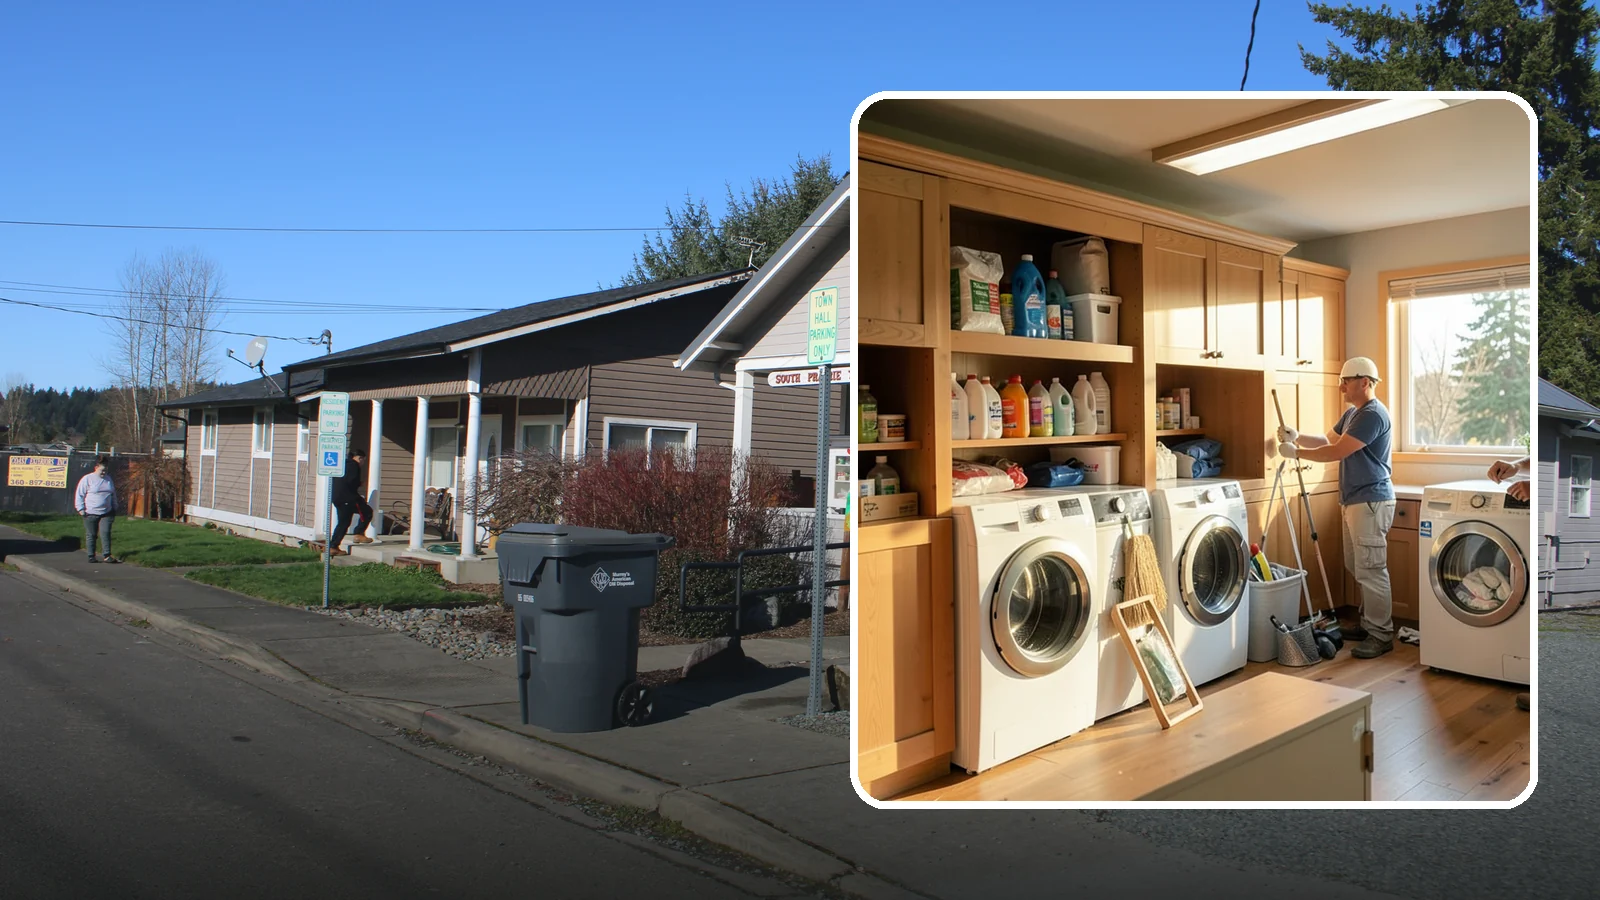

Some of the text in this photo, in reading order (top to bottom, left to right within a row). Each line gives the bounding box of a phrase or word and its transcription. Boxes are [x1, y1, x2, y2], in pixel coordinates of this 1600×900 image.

[815, 294, 833, 307] TOWN
[814, 312, 831, 324] HALL
[810, 327, 836, 340] PARKING
[813, 344, 831, 357] ONLY
[775, 373, 801, 384] SOUTH
